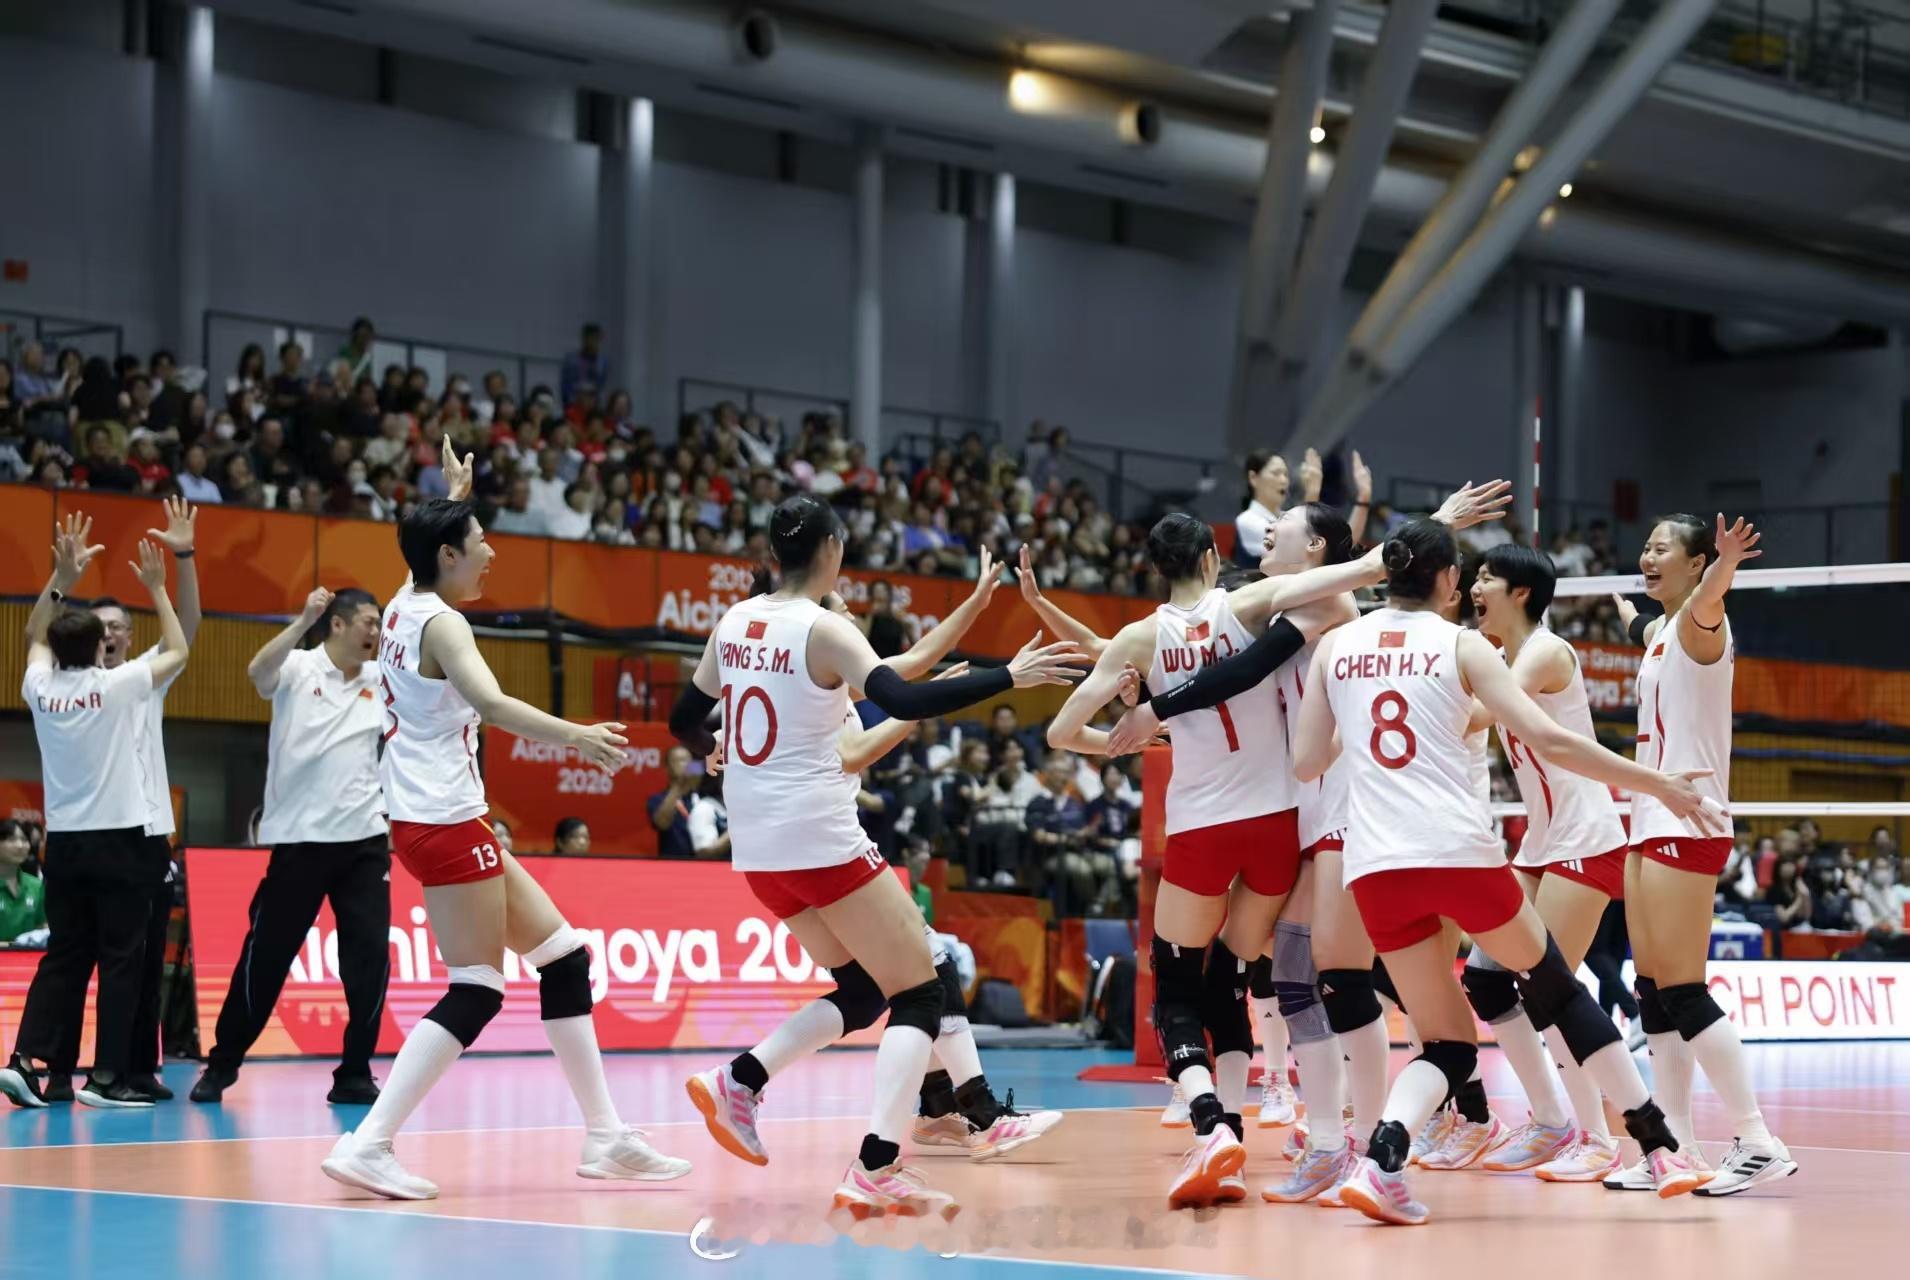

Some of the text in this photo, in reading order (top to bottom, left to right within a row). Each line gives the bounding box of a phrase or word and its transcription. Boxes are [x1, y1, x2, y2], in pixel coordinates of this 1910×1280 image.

[754, 647, 794, 675] S.M.
[1162, 633, 1240, 673] WU M.J.
[1334, 653, 1441, 680] CHEN H.Y.
[38, 692, 101, 713] CHINA
[721, 684, 778, 766] 10
[1370, 690, 1417, 770] 8
[558, 767, 613, 795] 2026
[472, 844, 498, 871] 13
[1780, 975, 1896, 1027] POINT
